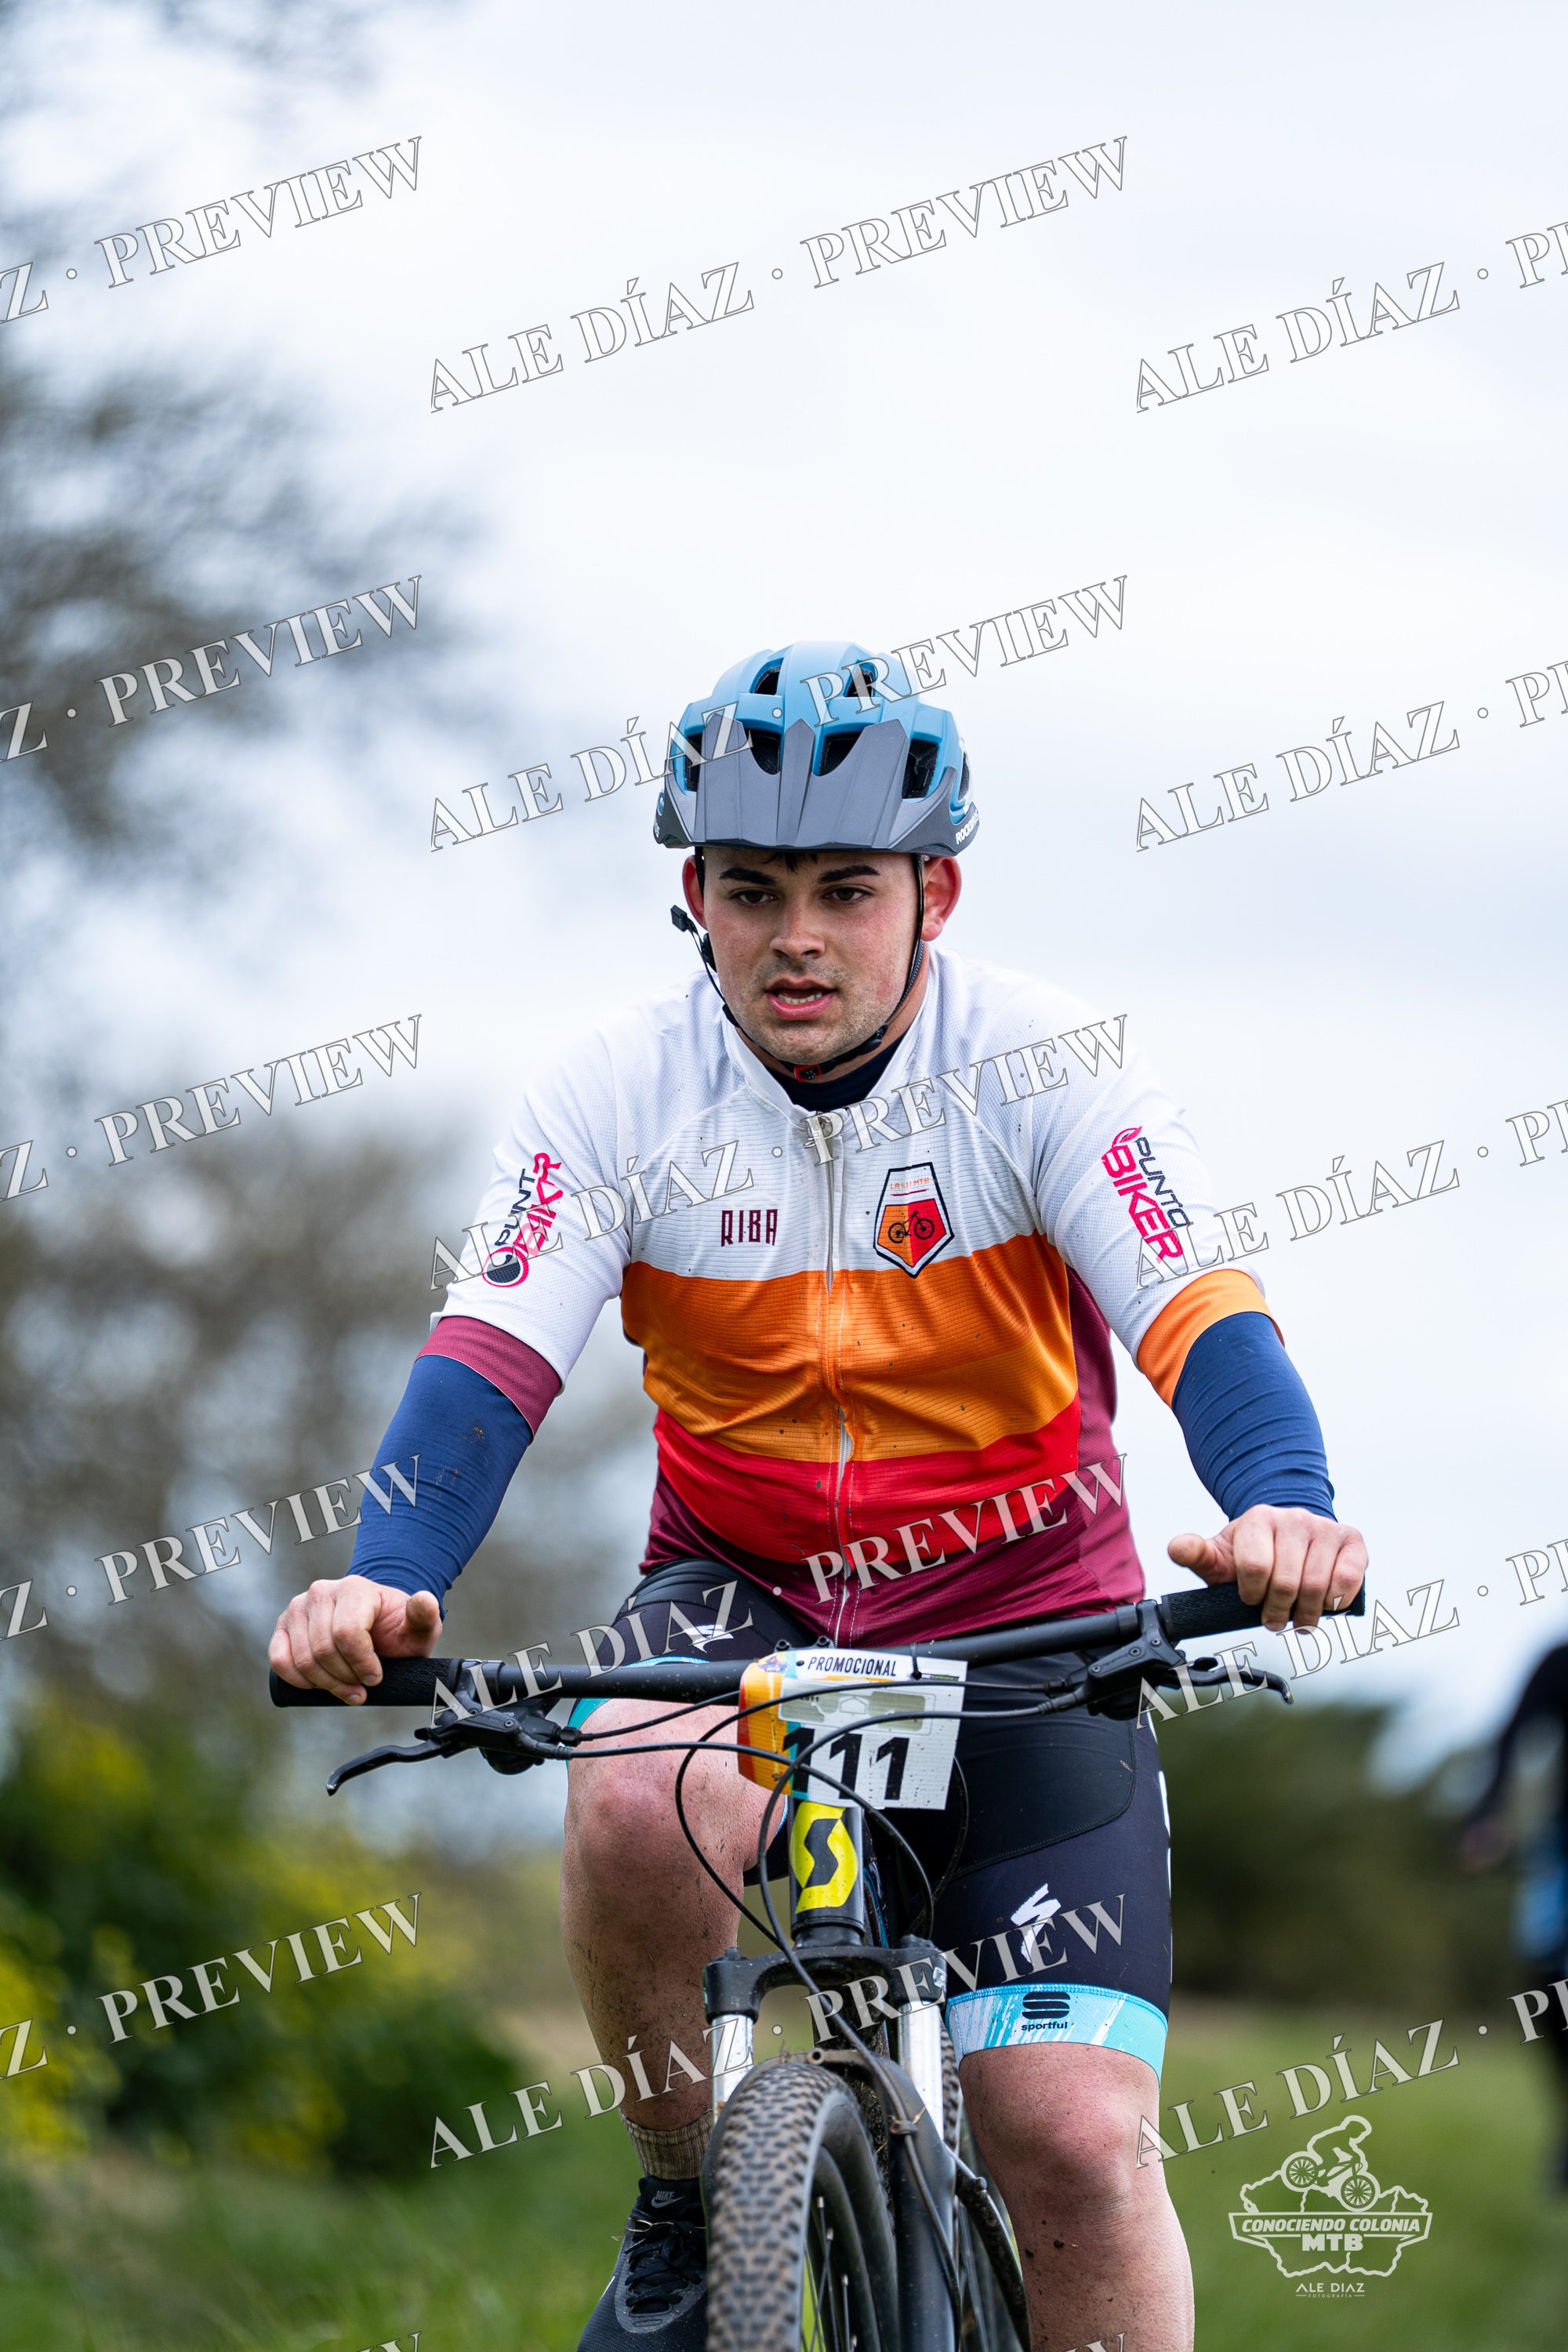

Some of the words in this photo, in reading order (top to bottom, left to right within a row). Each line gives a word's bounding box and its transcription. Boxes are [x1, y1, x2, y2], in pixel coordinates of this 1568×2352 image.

[494, 1168, 535, 1247] PUNT
[513, 1152, 564, 1258] BIKR
[1102, 1145, 1184, 1264] BIKER
[1134, 1136, 1190, 1228] PUNTO
[720, 1209, 778, 1247] RIBA
[807, 1657, 897, 1677] PROMOCIONAL
[782, 1727, 909, 1801] 111
[1021, 2021, 1068, 2032] sportful
[655, 2190, 675, 2201] NIKE
